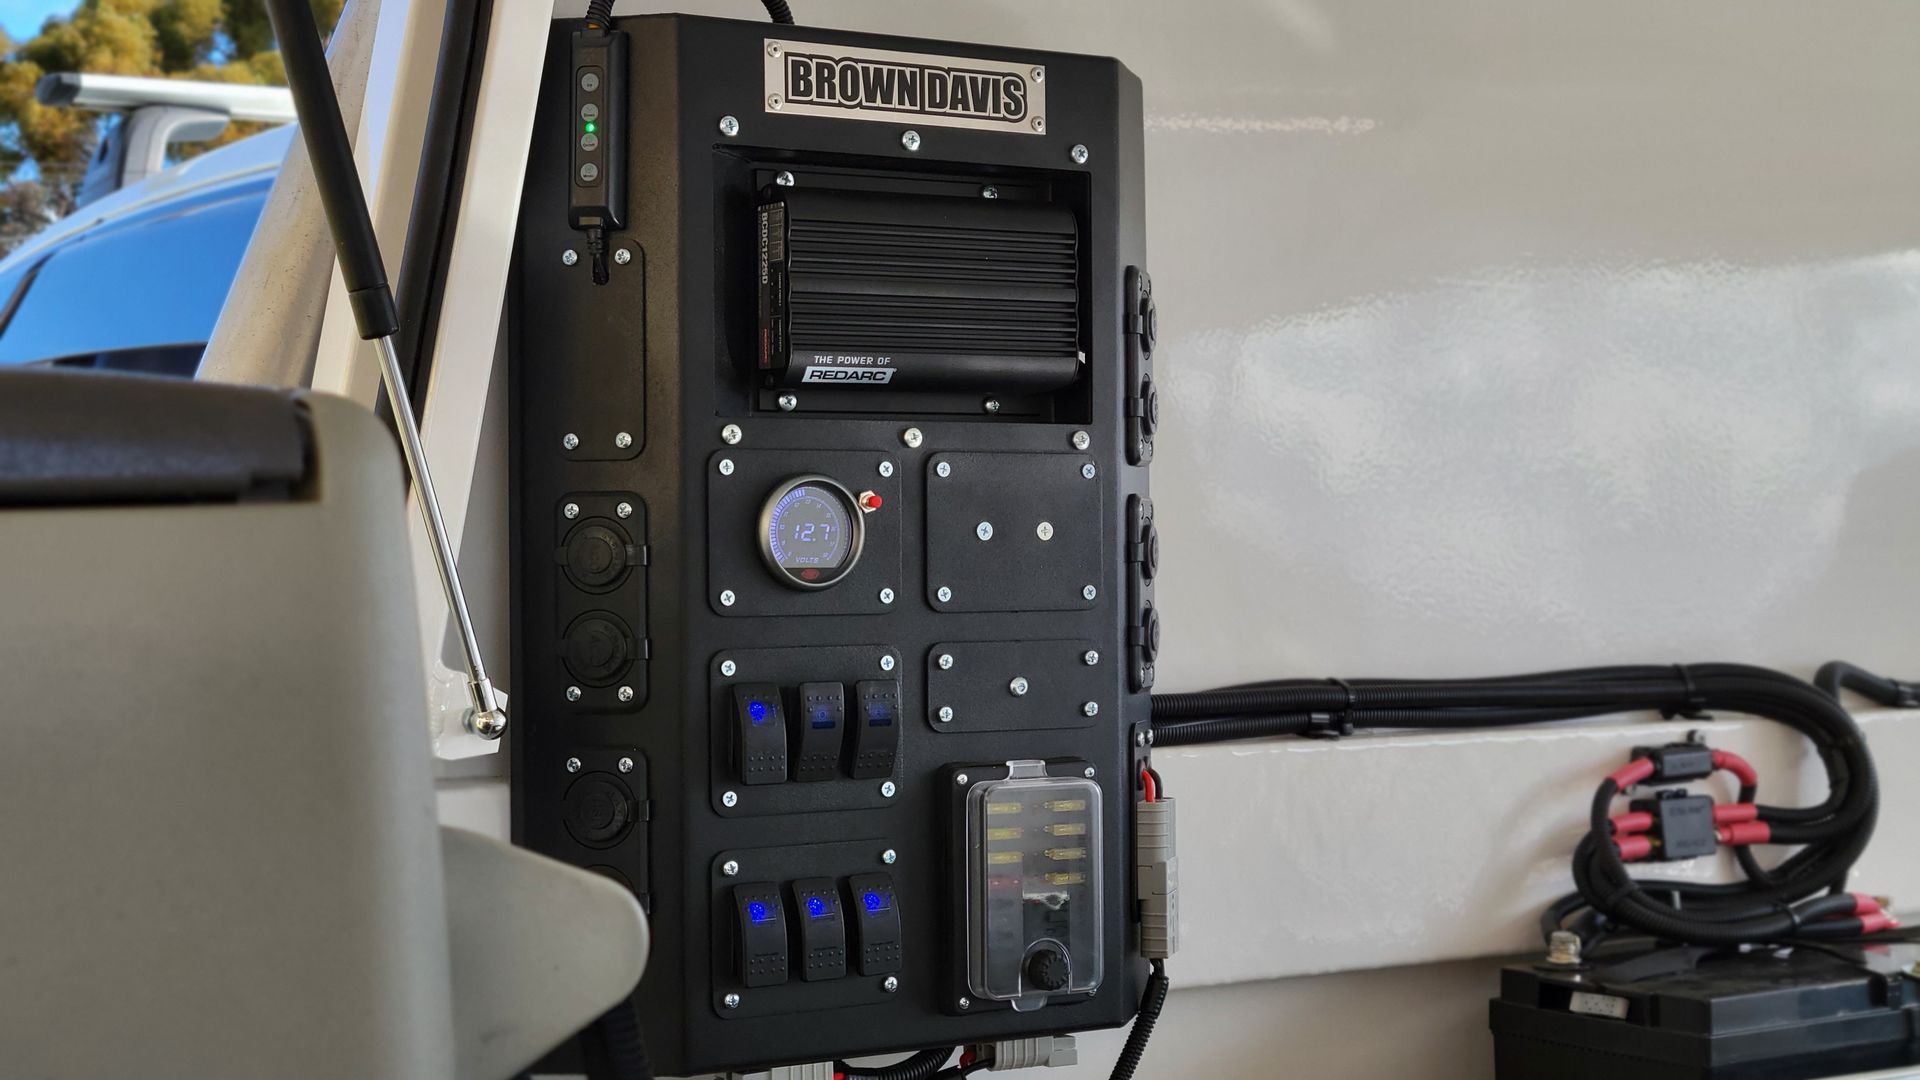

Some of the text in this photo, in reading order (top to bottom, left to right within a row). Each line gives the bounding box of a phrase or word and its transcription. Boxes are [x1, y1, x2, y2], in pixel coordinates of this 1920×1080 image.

[789, 58, 1026, 117] BROWN DAVIS
[814, 355, 891, 365] THE POWER OF
[809, 369, 887, 381] REDARC
[794, 523, 830, 541] 12.7
